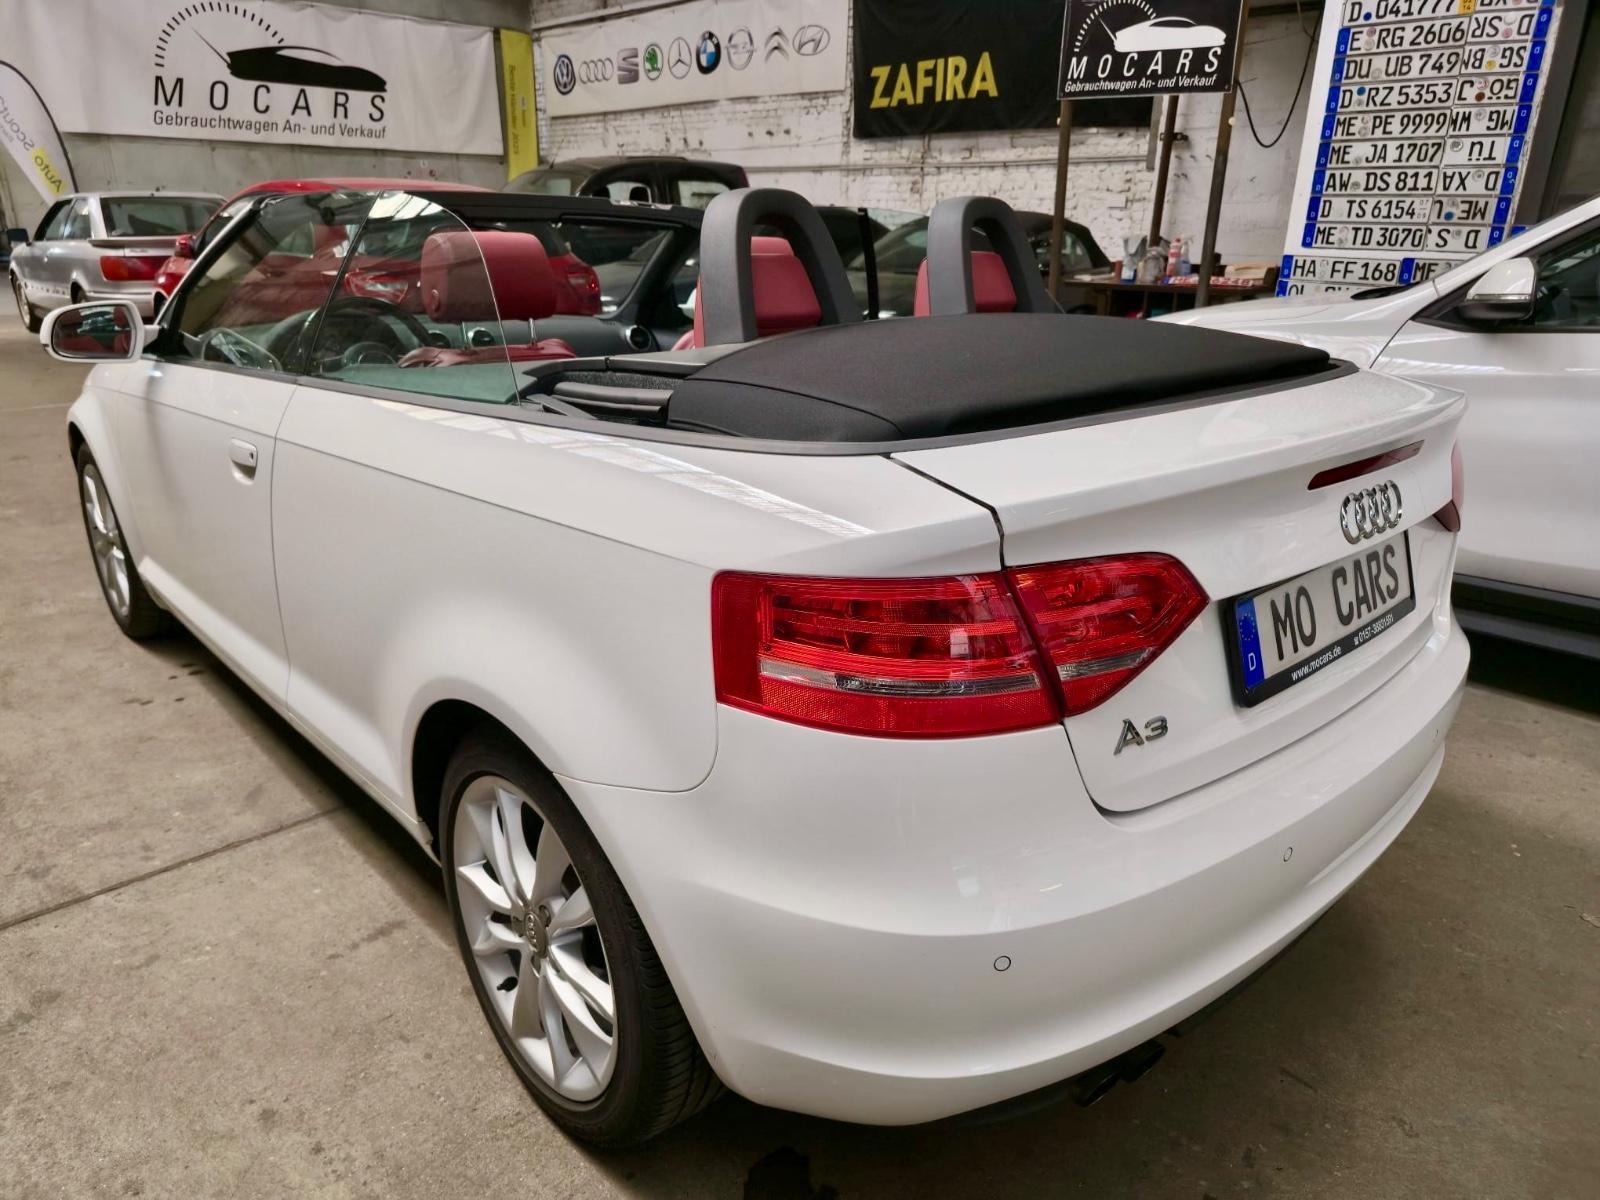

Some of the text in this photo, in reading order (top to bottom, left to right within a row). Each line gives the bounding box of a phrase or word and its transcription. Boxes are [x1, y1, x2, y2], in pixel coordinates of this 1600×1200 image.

[1348, 2, 1362, 22] D
[1350, 31, 1363, 51] E
[1376, 26, 1405, 49] RG
[1409, 21, 1465, 46] 2606
[1471, 15, 1503, 38] SR
[1517, 14, 1536, 36] D
[1344, 58, 1372, 80] DU
[1384, 55, 1413, 77] UB
[1419, 51, 1460, 75] 749
[1499, 46, 1528, 68] SG
[870, 51, 999, 110] ZAFIRA
[1064, 74, 1218, 93] Gebrauchtwagen An- und Verkauf
[1339, 88, 1354, 109] D
[1365, 86, 1393, 108] RZ
[1397, 82, 1453, 105] 5353
[153, 110, 387, 139] Gebrauchtwagen An- und Verkauf
[1334, 116, 1358, 137] ME
[1371, 114, 1395, 135] PE
[1399, 112, 1448, 135] 9999
[1486, 109, 1515, 131] MG
[1328, 145, 1353, 165] ME
[1365, 144, 1387, 163] JA
[1393, 142, 1442, 163] 1707
[1325, 172, 1352, 192] AW
[1363, 171, 1391, 192] DS
[1395, 171, 1434, 192] 811
[1442, 171, 1471, 192] XA
[1484, 171, 1500, 192] D
[1320, 200, 1332, 218] D
[1346, 199, 1368, 219] TS
[1371, 199, 1416, 219] 6154
[1457, 200, 1489, 220] ME
[1314, 227, 1337, 245] ME
[1351, 227, 1374, 246] TD
[1376, 228, 1424, 248] 3070
[1464, 229, 1481, 249] D
[1293, 259, 1317, 278] HA
[1330, 260, 1358, 279] FF
[1358, 262, 1397, 282] 168
[1248, 544, 1399, 671] D MO CARS
[1291, 645, 1342, 681] www.mocars.de
[1113, 714, 1169, 756] A3
